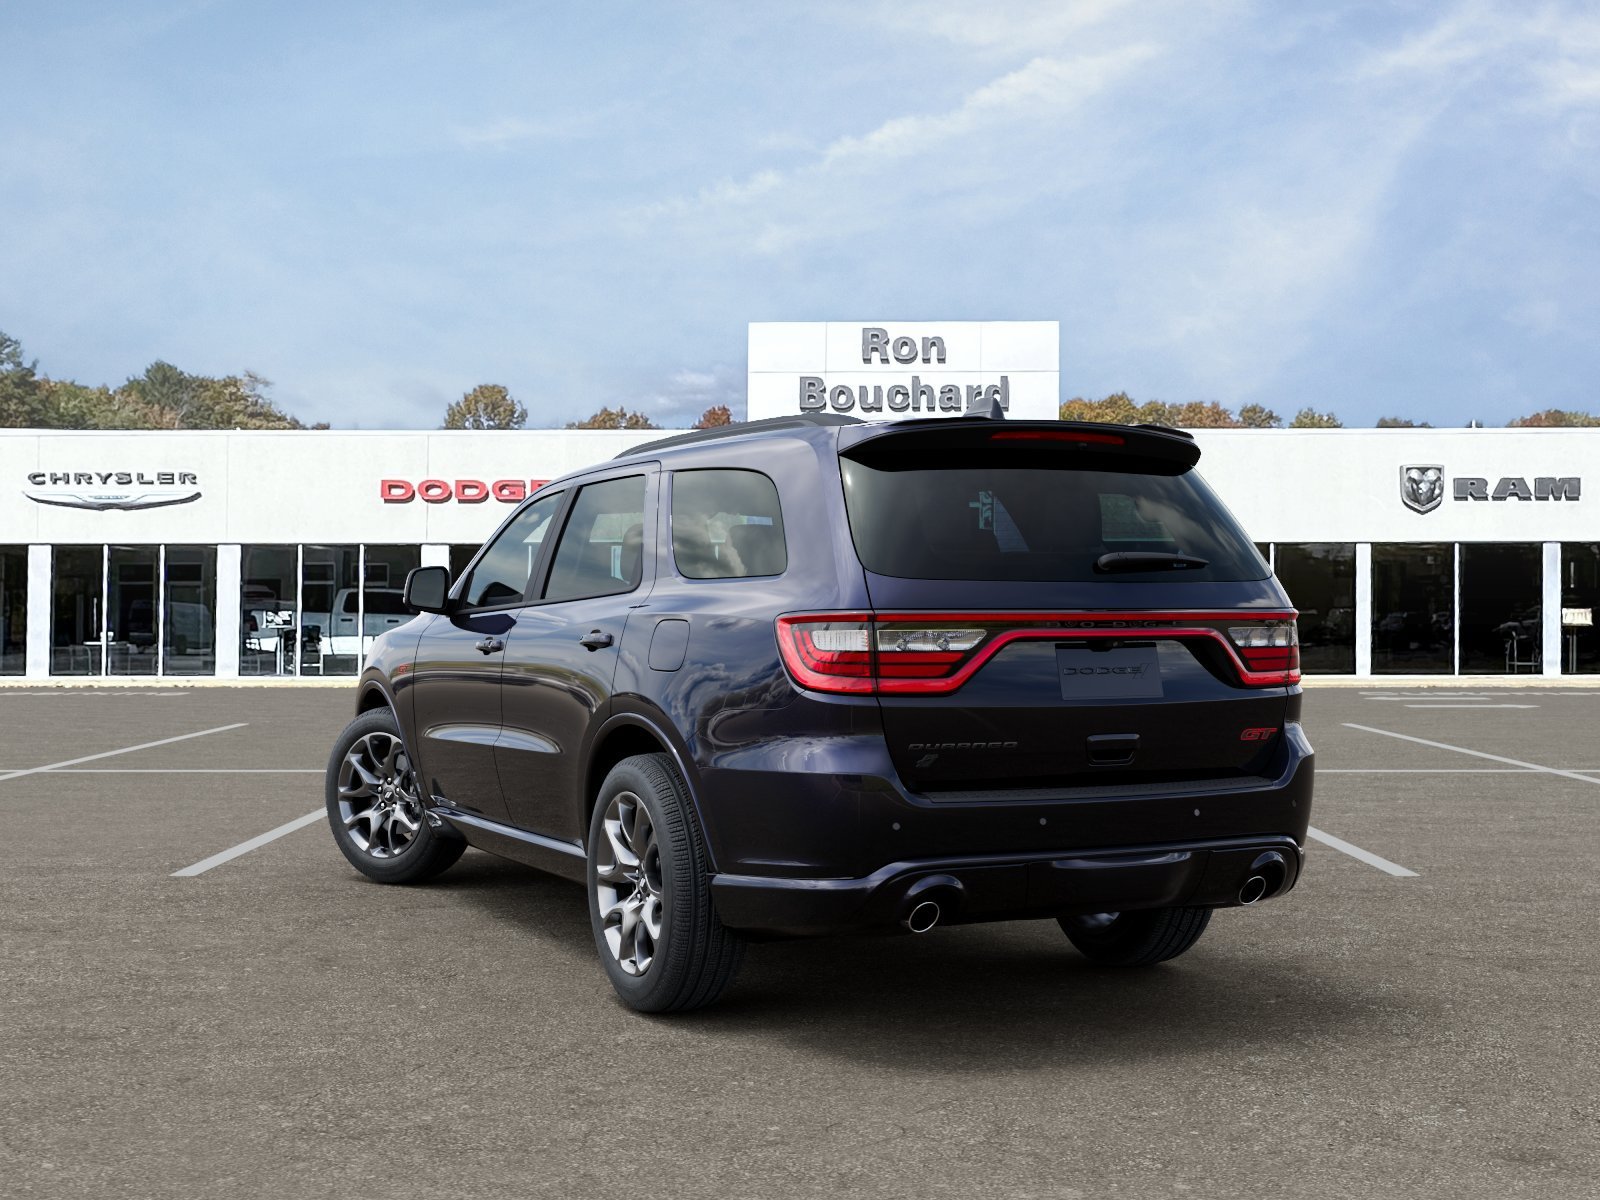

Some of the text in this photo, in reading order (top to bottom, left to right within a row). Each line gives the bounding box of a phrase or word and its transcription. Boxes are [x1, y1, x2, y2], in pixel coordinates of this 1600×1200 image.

[861, 327, 947, 364] Ron
[799, 375, 1010, 412] Bouchard
[27, 472, 198, 485] CHRYSLER
[1453, 477, 1581, 501] RAM
[1063, 666, 1143, 676] DODGE
[1240, 727, 1278, 741] GT
